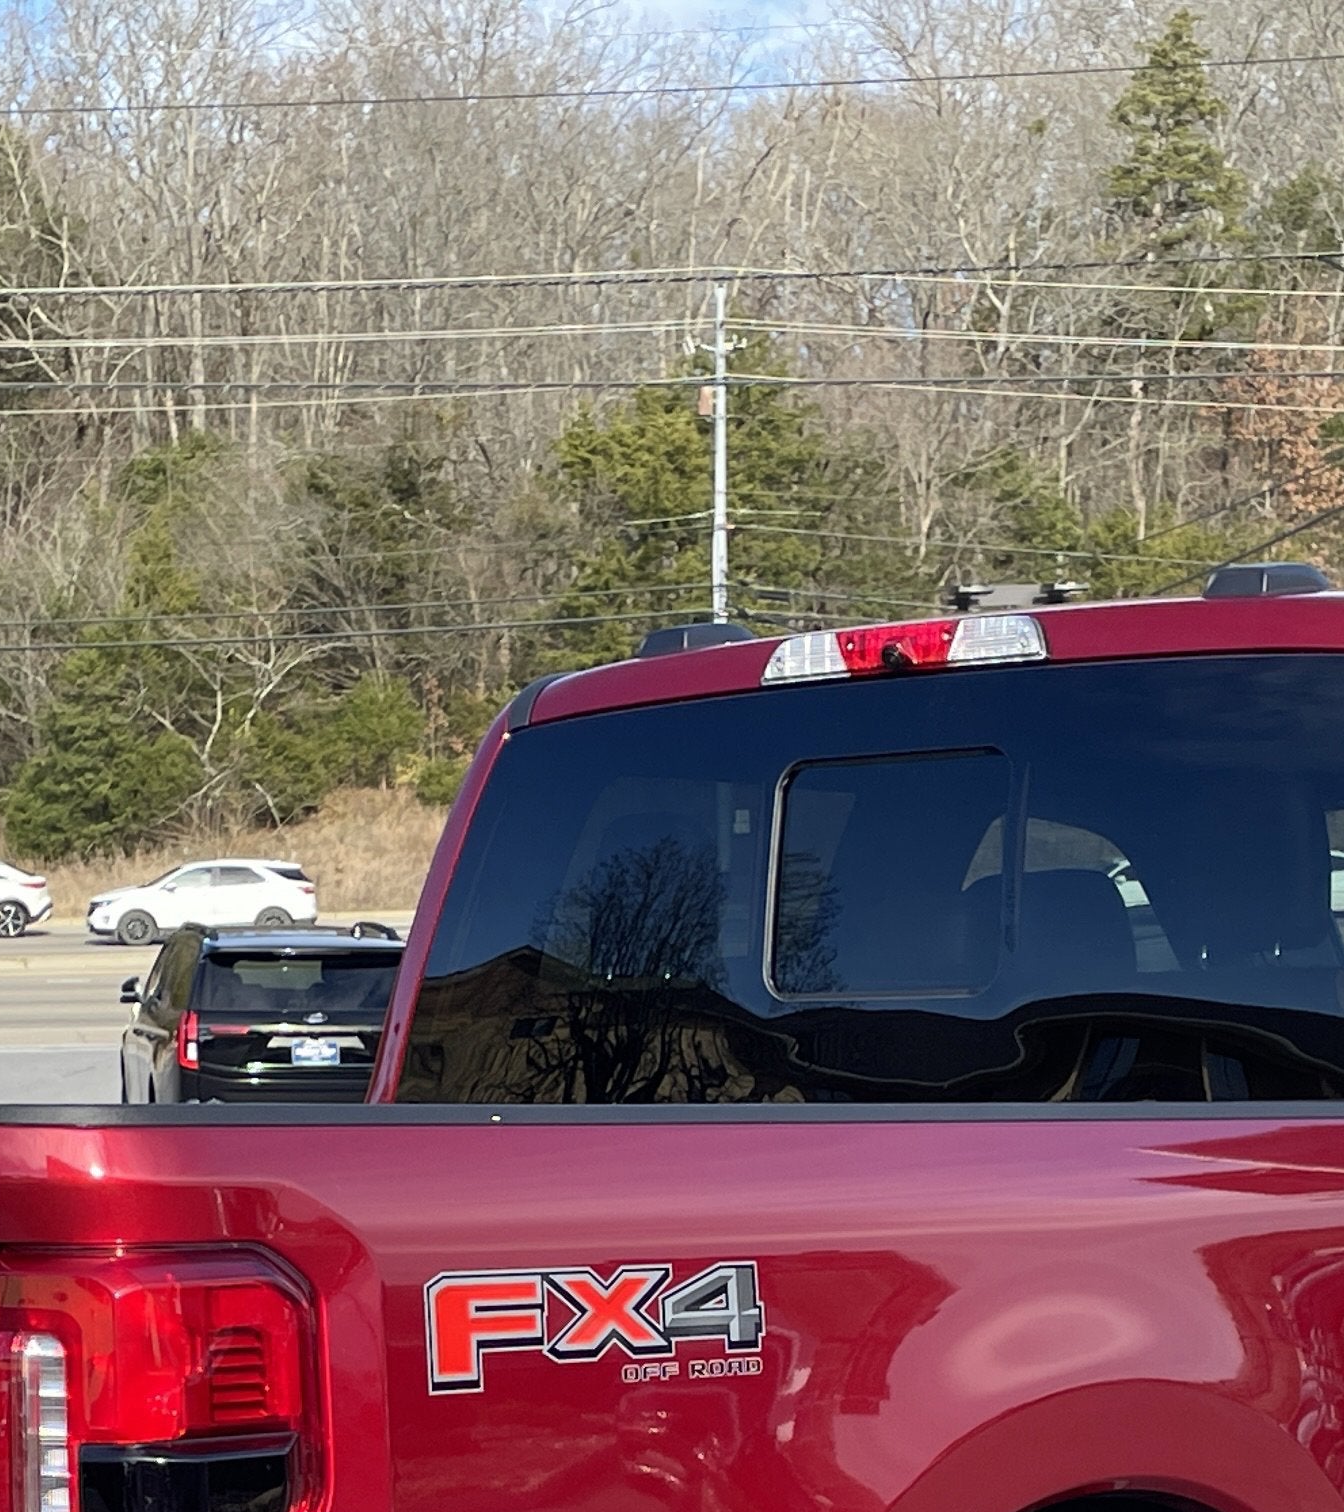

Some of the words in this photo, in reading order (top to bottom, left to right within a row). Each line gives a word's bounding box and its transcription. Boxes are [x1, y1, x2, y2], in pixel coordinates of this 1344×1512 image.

[423, 1261, 767, 1396] FX4
[622, 1362, 680, 1384] OFF
[688, 1356, 764, 1381] ROAD
